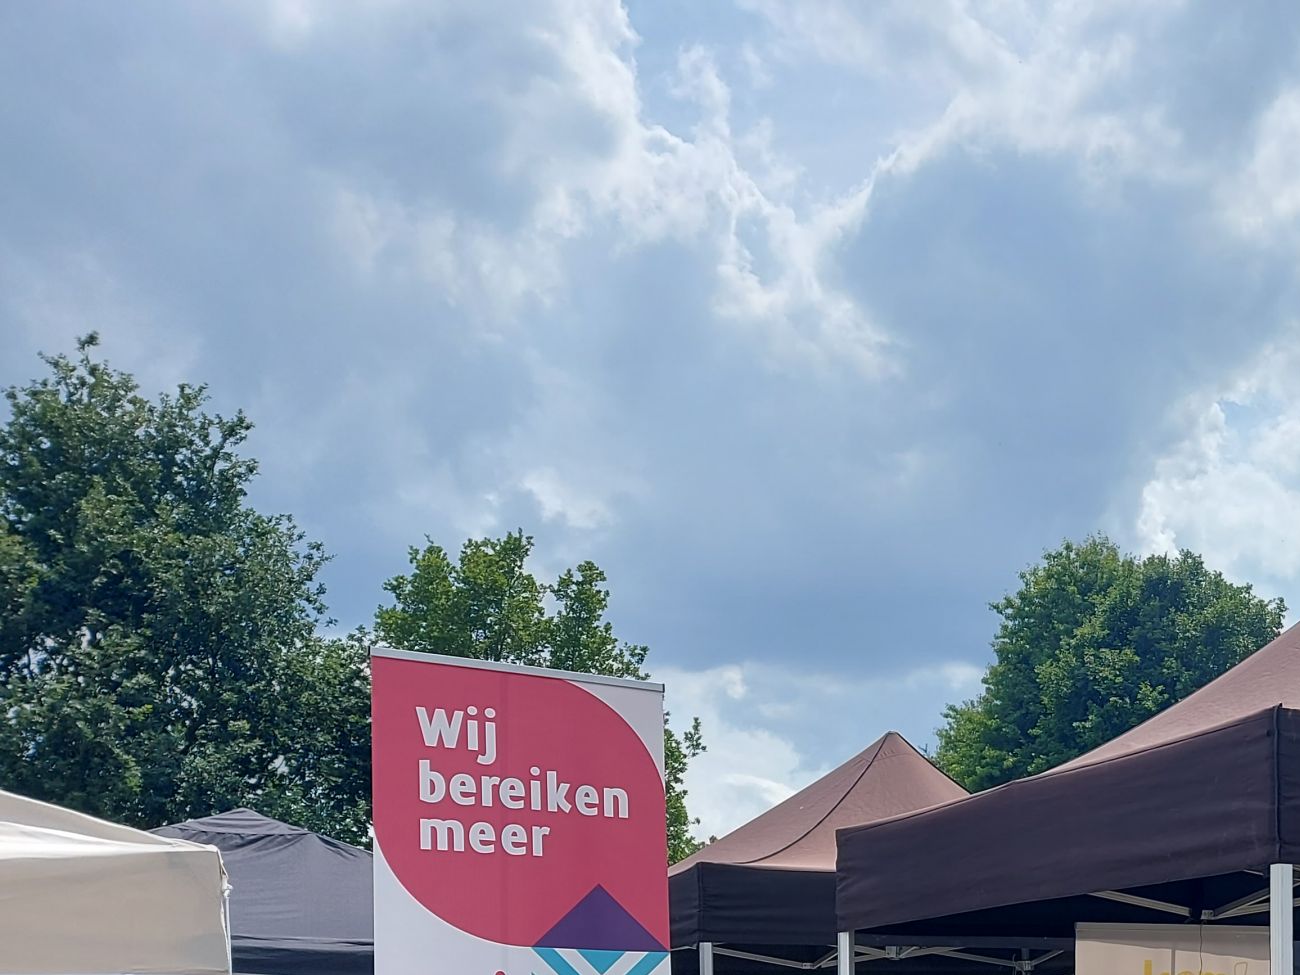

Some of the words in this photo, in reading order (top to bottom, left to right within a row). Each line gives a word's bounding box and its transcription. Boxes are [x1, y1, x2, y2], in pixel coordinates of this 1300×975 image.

[415, 705, 498, 764] Wij
[417, 760, 629, 819] bereiken
[419, 817, 550, 857] meer
